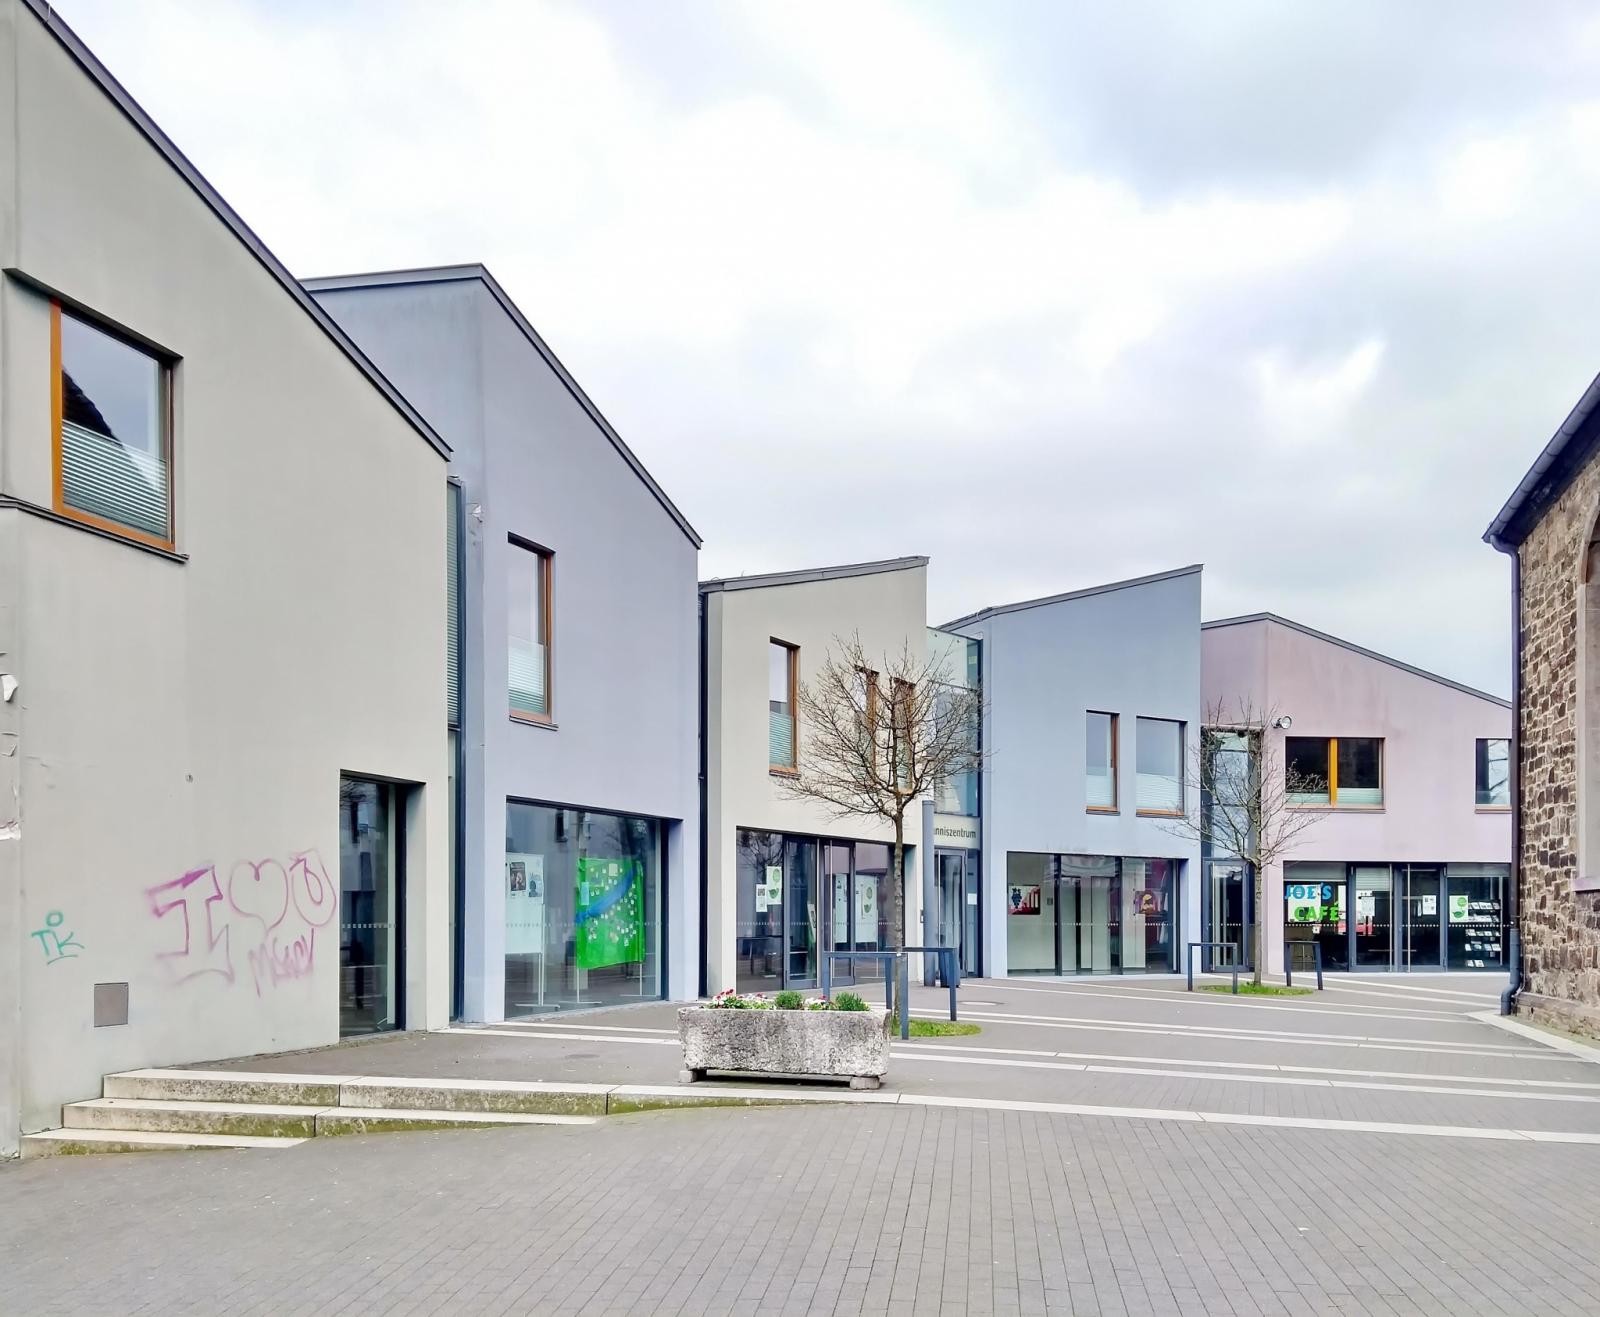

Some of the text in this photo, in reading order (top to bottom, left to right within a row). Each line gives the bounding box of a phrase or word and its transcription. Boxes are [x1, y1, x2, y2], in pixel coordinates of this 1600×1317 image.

[934, 827, 977, 839] nniszentrum
[1283, 883, 1332, 900] JOE'S
[1294, 900, 1339, 921] CAFÉ
